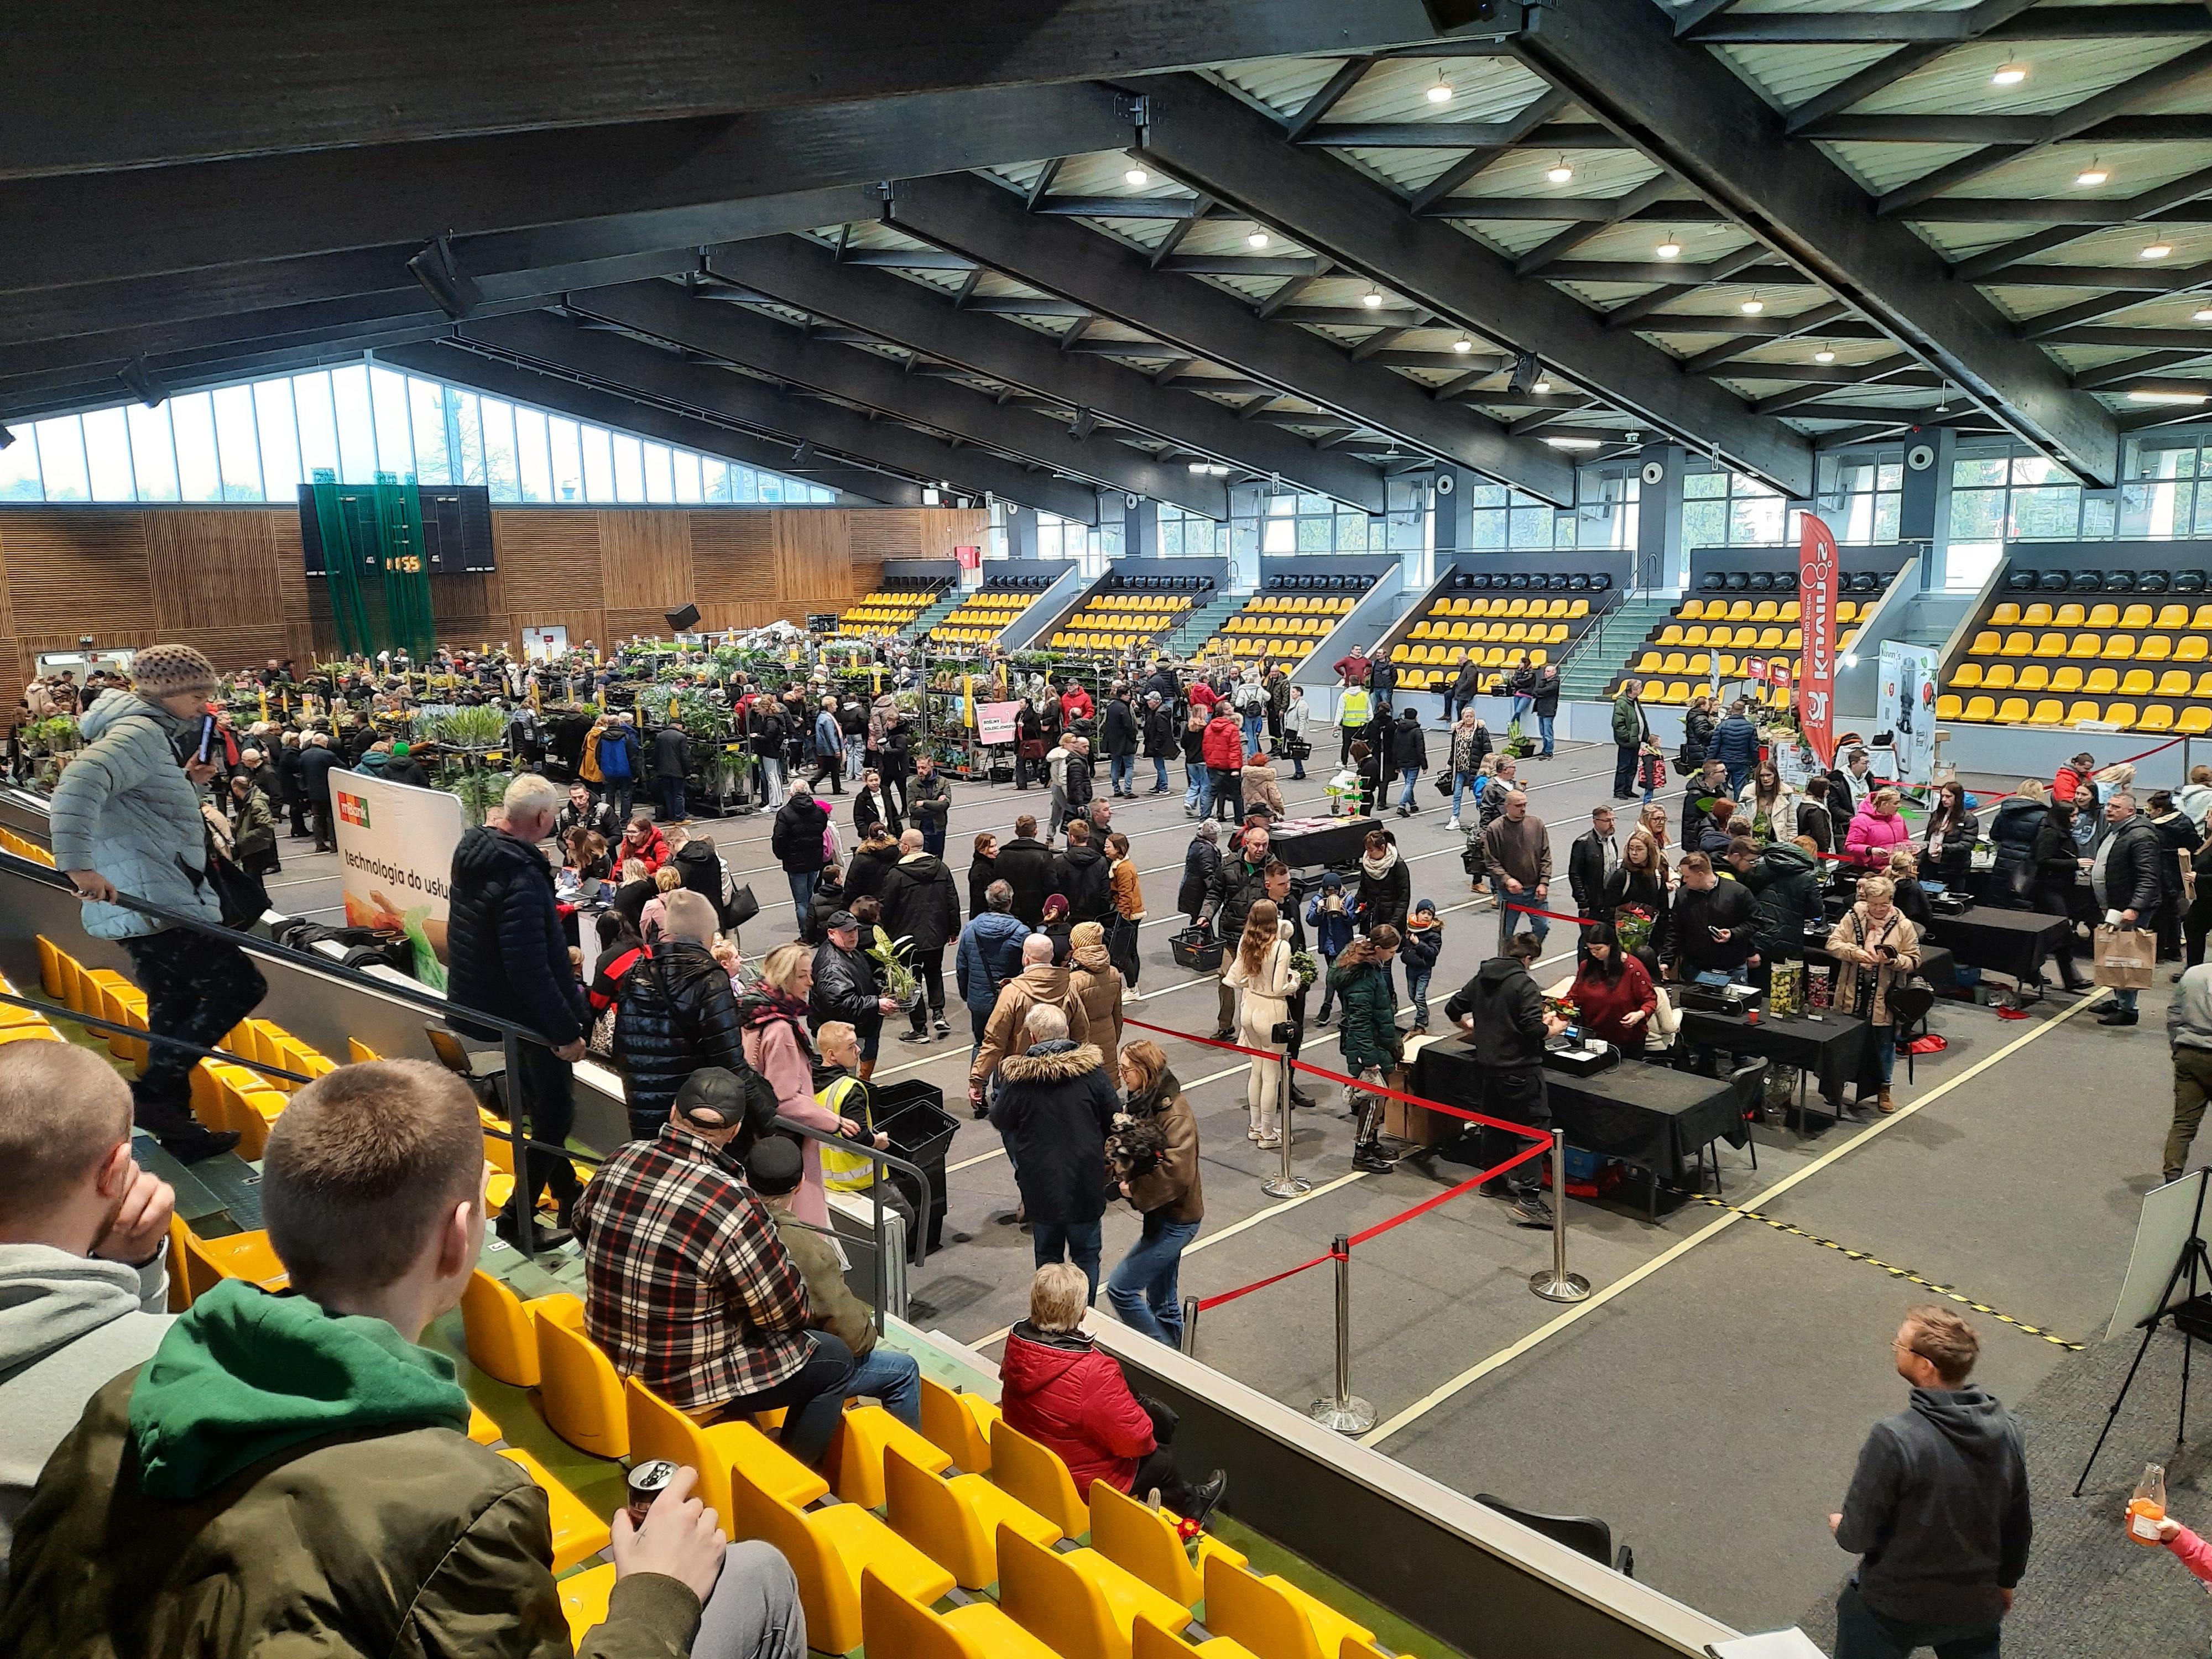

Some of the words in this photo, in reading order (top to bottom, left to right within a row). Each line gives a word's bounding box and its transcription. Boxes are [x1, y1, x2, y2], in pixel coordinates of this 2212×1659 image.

[1274, 481, 1278, 493] B
[988, 498, 992, 508] A
[341, 801, 367, 820] mBank
[345, 848, 405, 885] technologia
[408, 869, 421, 890] do
[424, 877, 449, 900] usłu
